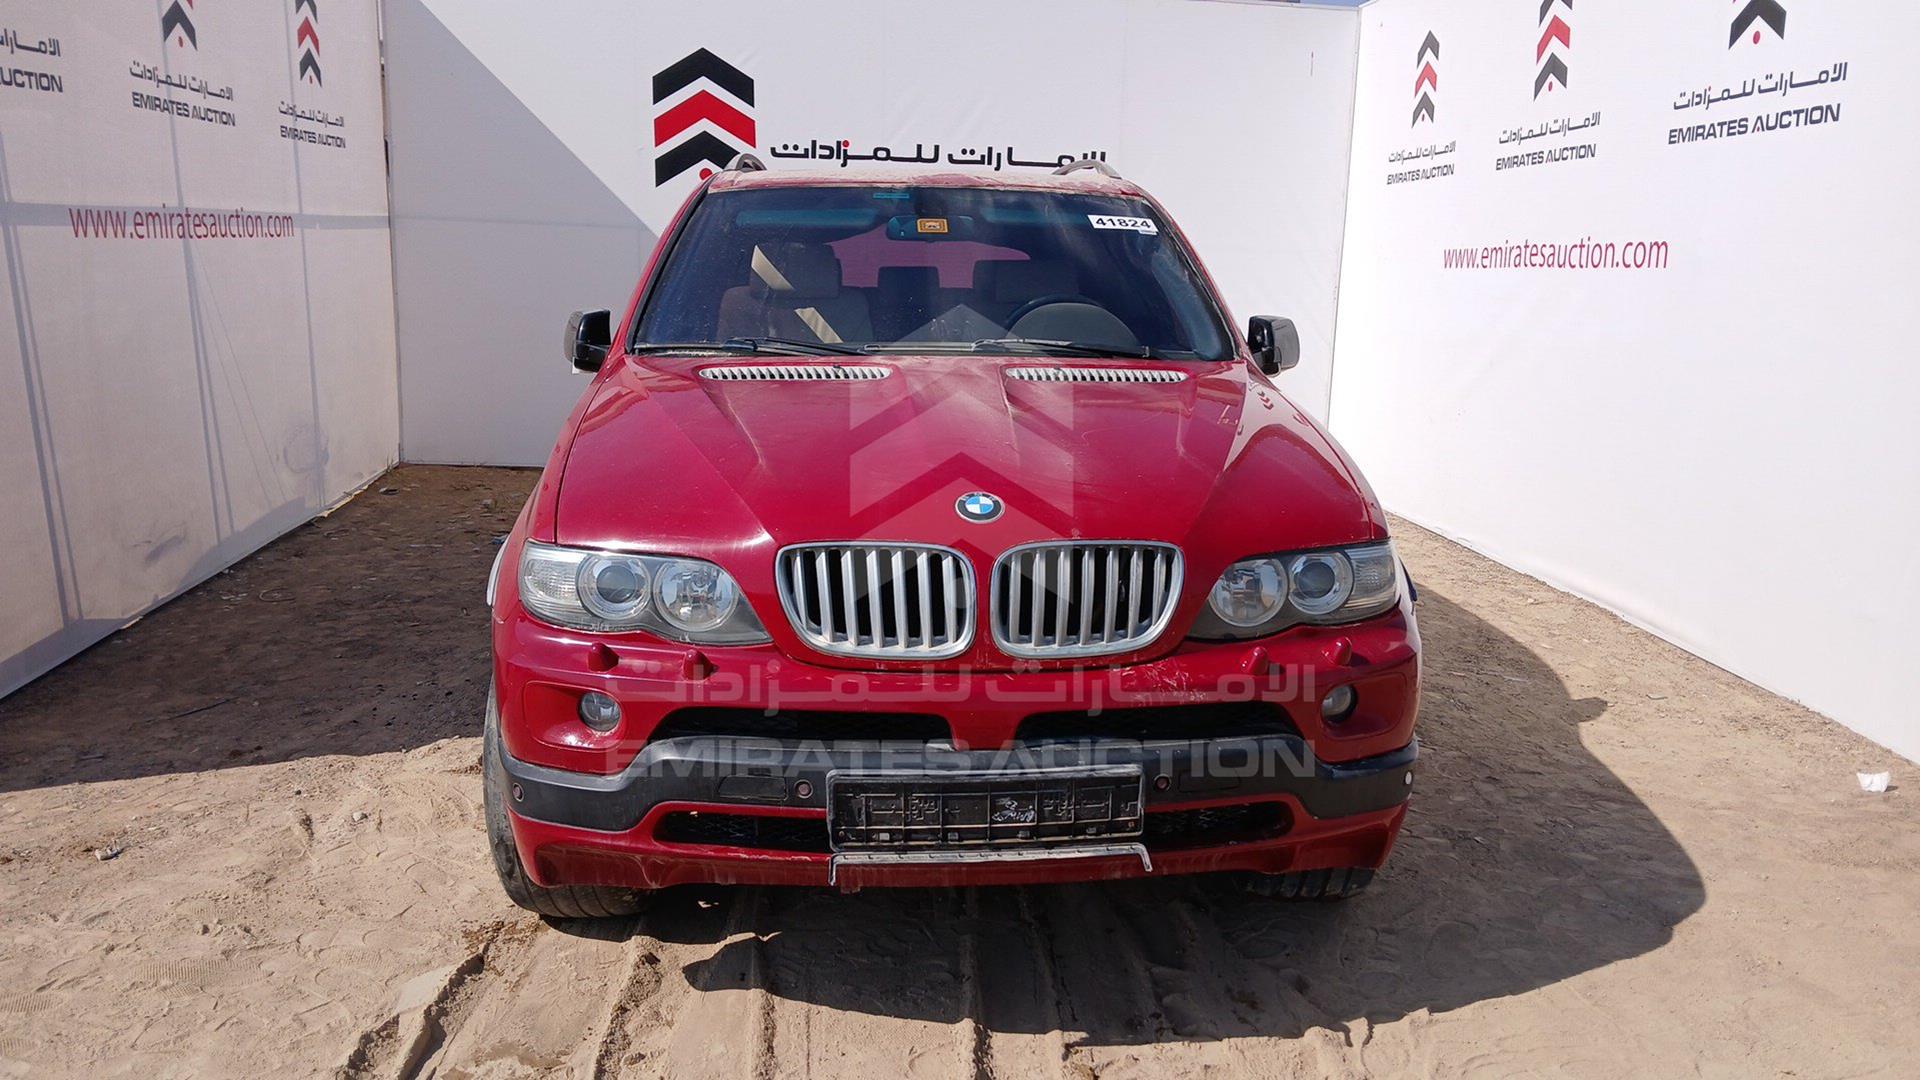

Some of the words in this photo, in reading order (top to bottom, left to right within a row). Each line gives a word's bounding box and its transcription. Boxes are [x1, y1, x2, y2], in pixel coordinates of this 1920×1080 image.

[0, 67, 63, 93] UCTION
[132, 91, 190, 118] EMIRATES
[192, 105, 236, 127] AUCTION
[280, 125, 317, 144] EMIRATES
[318, 133, 346, 149] AUCTION
[1668, 117, 1749, 145] EMIRATES
[1751, 103, 1841, 133] AUCTION
[1496, 151, 1545, 170] EMIRATES
[1545, 143, 1597, 163] AUCTION
[1387, 169, 1421, 185] EMIRATES
[1421, 163, 1455, 180] AUCTION
[69, 203, 295, 239] www.emiratesauction.com
[1095, 217, 1151, 229] 41824
[1443, 236, 1669, 269] www.emiratesauction.com
